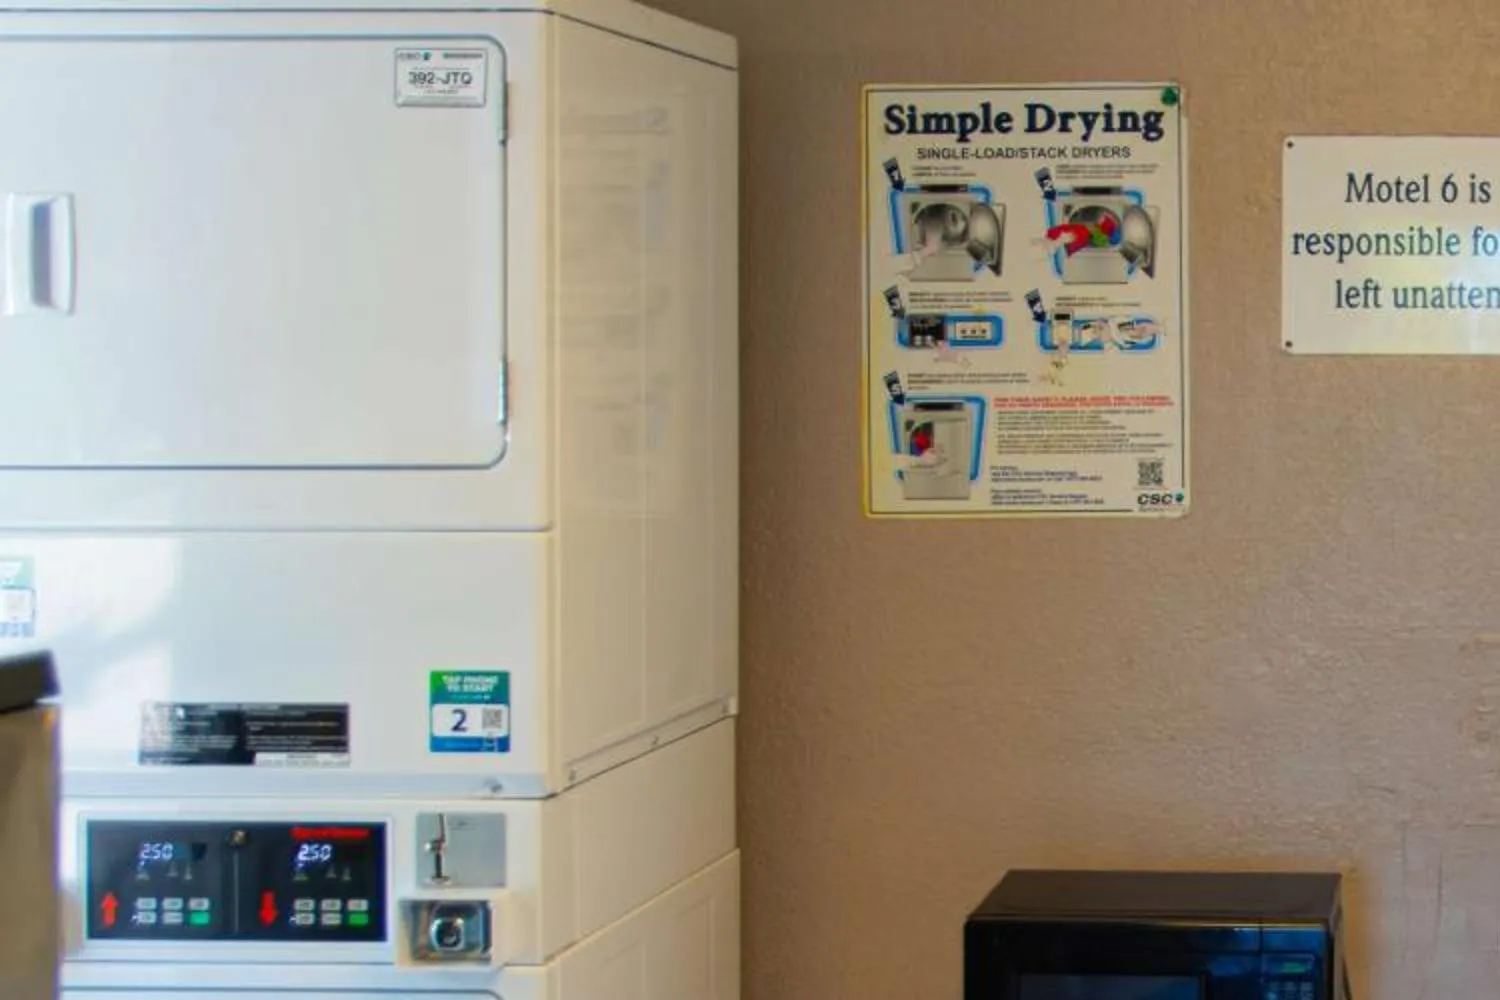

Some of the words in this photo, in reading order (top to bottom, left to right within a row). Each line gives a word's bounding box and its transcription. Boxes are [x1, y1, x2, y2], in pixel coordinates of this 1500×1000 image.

[884, 102, 1014, 143] Simple
[1024, 102, 1165, 141] Drying
[917, 146, 1067, 160] SINGLE-LOAD/STACK
[1071, 146, 1132, 159] DRYERS
[1344, 172, 1430, 204] Motel
[1441, 173, 1458, 204] 6
[1469, 172, 1491, 204] is
[1292, 226, 1461, 264] responsible
[1335, 278, 1382, 310] left
[1137, 493, 1174, 506] CSC
[450, 709, 469, 732] 2
